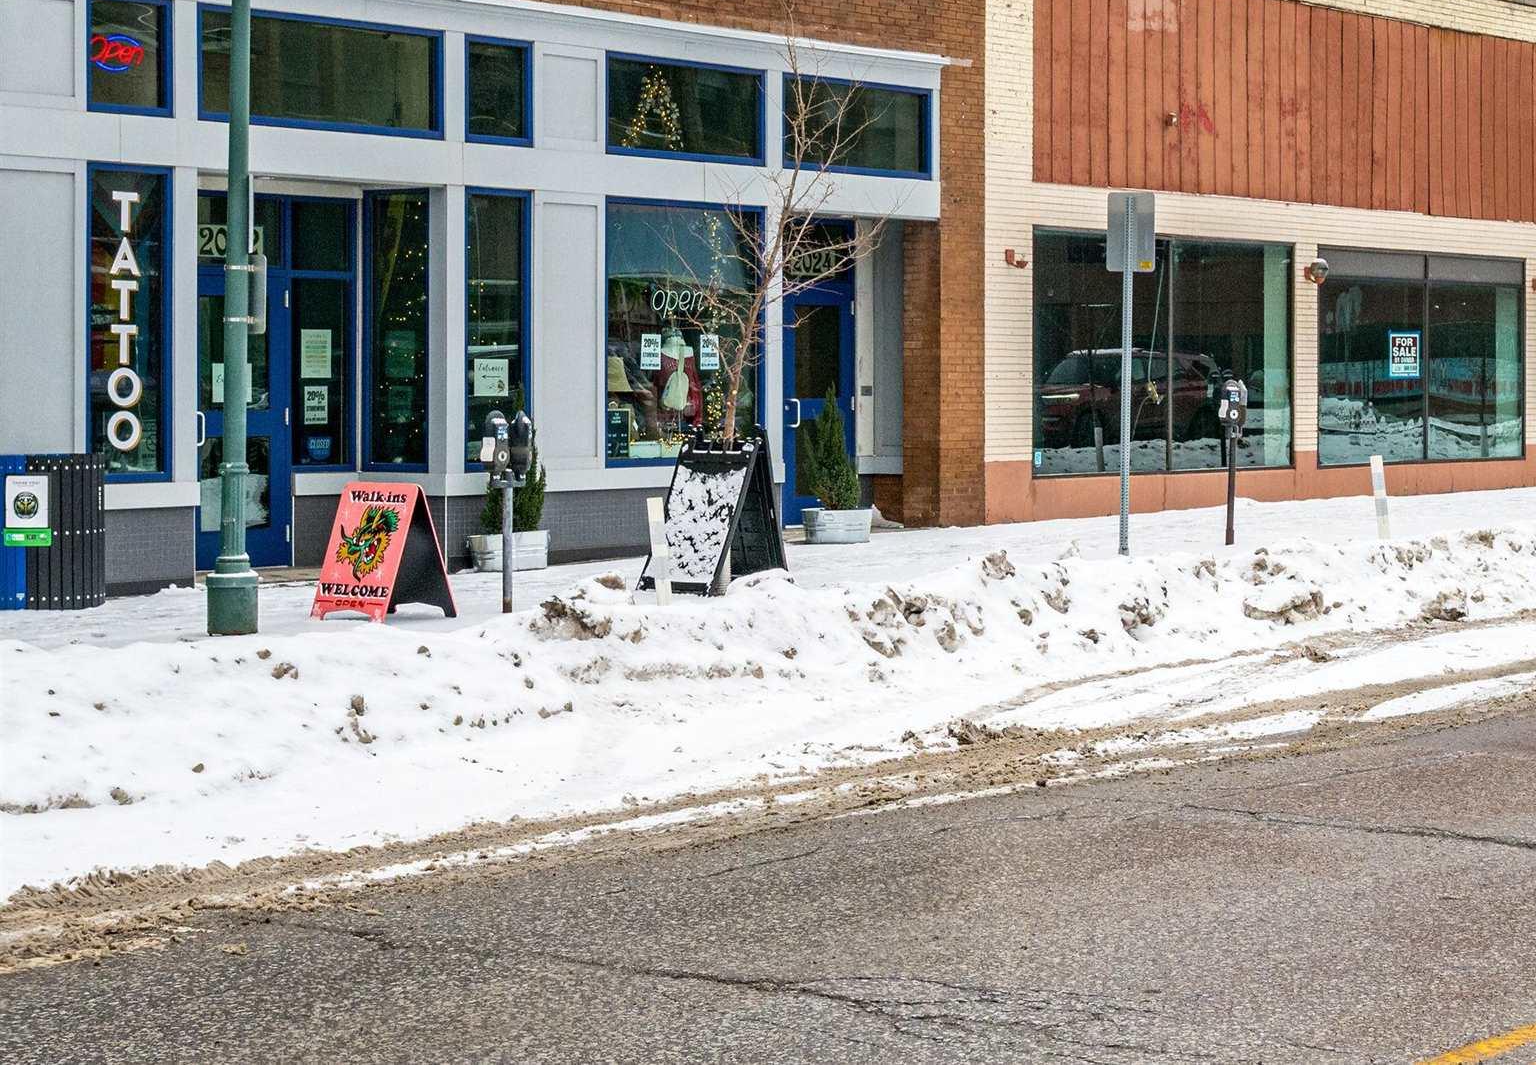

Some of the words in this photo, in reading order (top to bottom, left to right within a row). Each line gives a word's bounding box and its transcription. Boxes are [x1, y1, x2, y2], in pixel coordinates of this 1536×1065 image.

[652, 288, 704, 318] open
[107, 190, 143, 452] TATTOO
[1396, 338, 1413, 346] FOR
[1393, 347, 1416, 356] SALE
[306, 390, 325, 401] 20%
[320, 583, 389, 597] WELCOME
[334, 599, 367, 608] OPEN
